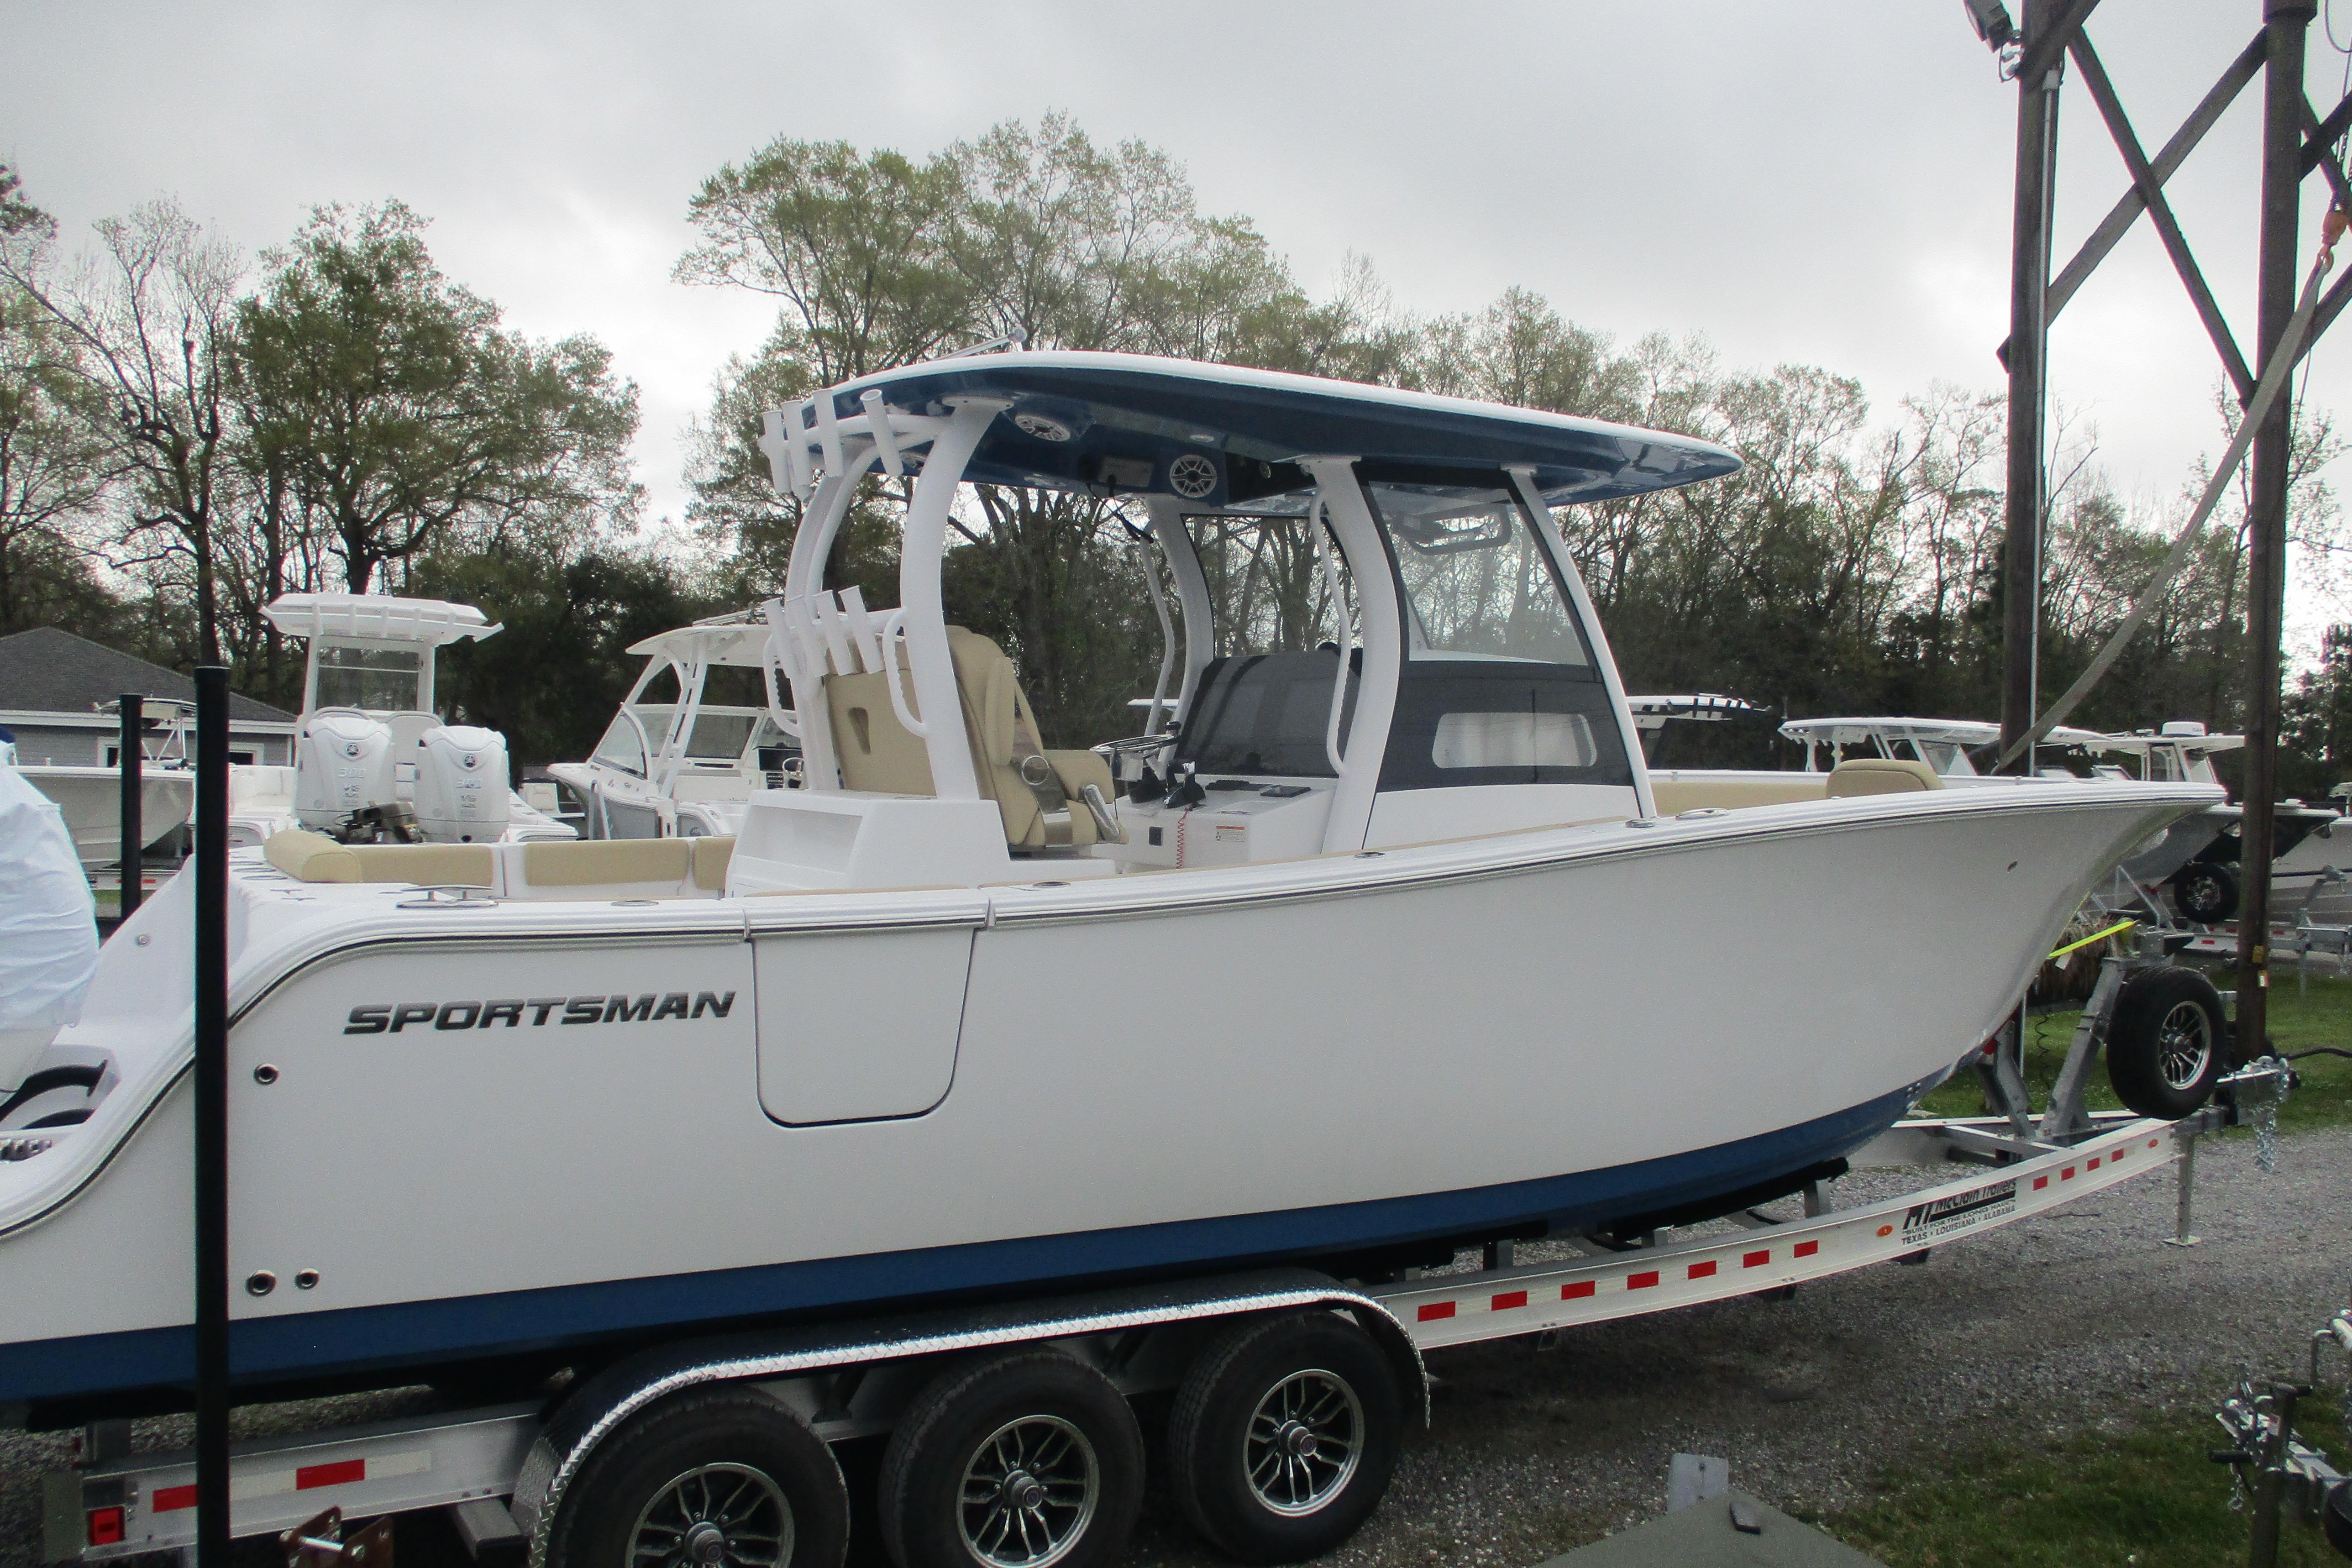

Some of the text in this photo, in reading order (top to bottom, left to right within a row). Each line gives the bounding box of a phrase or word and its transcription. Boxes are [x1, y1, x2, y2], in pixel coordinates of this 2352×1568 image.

[343, 991, 736, 1035] SPORTSMAN
[1901, 1205, 2015, 1245] TEXAS LOUISIANA ALABAMA
